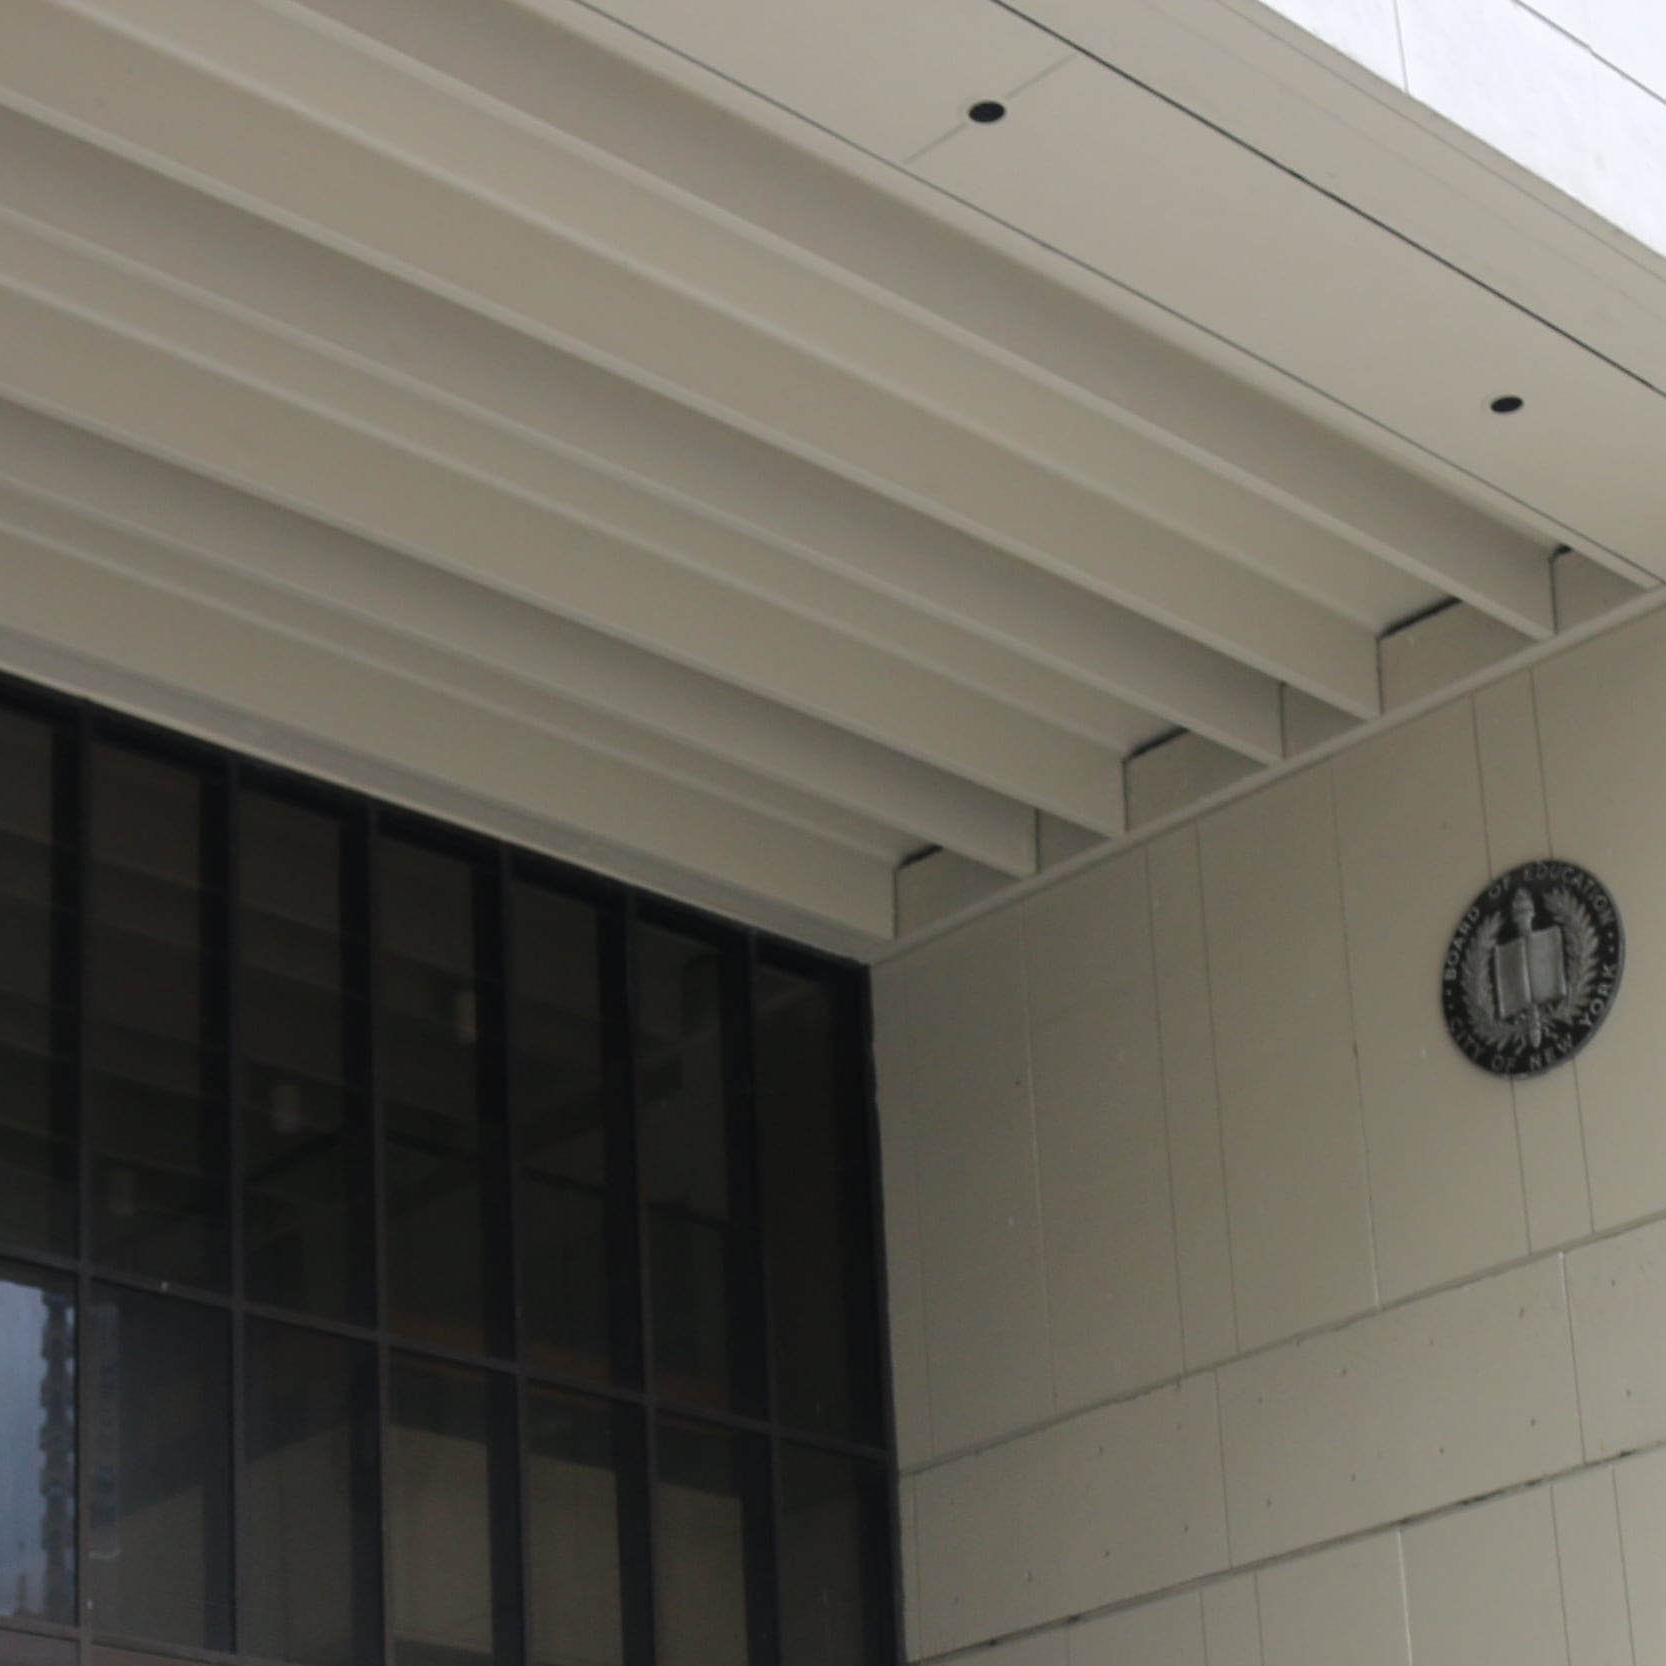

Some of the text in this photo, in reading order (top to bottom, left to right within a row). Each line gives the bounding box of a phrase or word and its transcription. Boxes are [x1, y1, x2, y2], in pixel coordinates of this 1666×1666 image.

[1444, 860, 1616, 981] BOARD OF EDUCATION
[1449, 962, 1618, 1072] CITY OF NEW YORK
